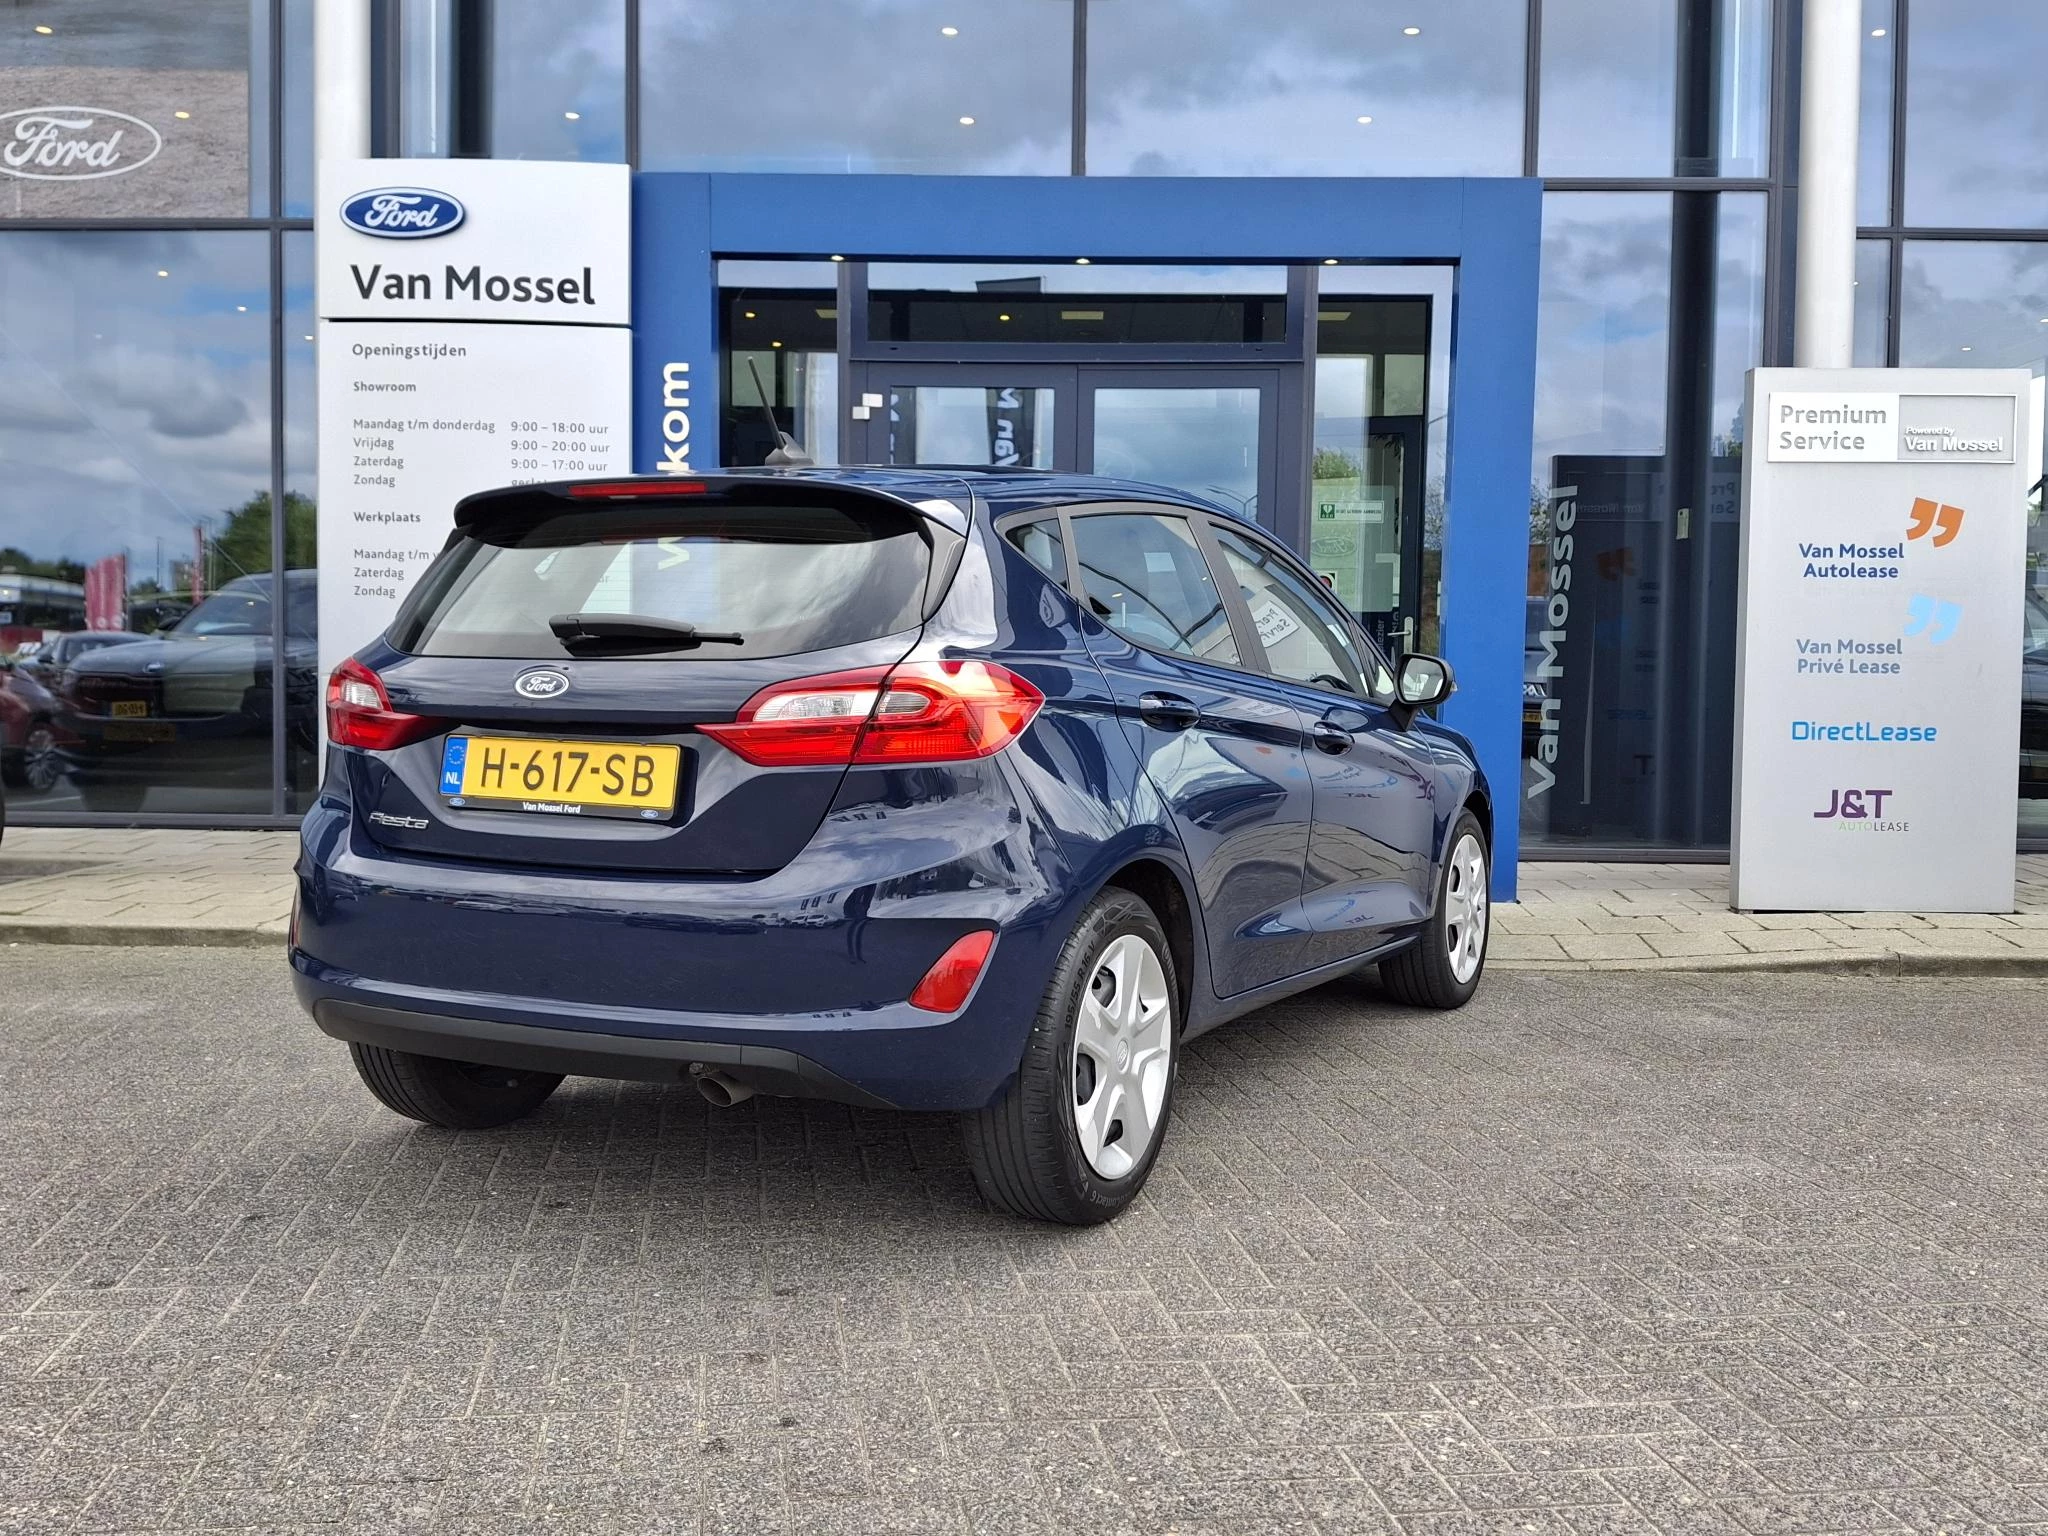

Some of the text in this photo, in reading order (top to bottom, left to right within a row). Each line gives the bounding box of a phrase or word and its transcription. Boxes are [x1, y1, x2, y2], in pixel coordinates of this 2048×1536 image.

[3, 116, 125, 168] Ford
[364, 194, 440, 228] Ford
[350, 264, 596, 305] Van Mossel
[352, 343, 467, 360] Openingstijden
[353, 381, 417, 392] Showroom
[1780, 405, 1887, 424] Premium
[353, 419, 405, 432] Maandag
[408, 419, 429, 430] t/m
[432, 419, 496, 433] donderdag
[511, 421, 538, 432] 9:00
[552, 422, 585, 434] 18:00
[589, 424, 609, 434] uur
[1905, 426, 1955, 437] Powered by
[353, 437, 394, 450] Vrijdag
[511, 440, 538, 451] 9:00
[552, 441, 587, 452] 20:00
[590, 443, 610, 453] uur
[1779, 431, 1865, 450] Service
[1904, 436, 2004, 453] Van Mossel
[354, 456, 404, 469] Zaterdag
[511, 458, 538, 470] 9:00
[553, 460, 584, 471] 17:00
[587, 462, 608, 472] uur
[354, 474, 396, 487] Zondag
[353, 511, 421, 523] Werkplaats
[354, 548, 405, 561] Maandag
[408, 549, 430, 560] t/m
[1799, 543, 1905, 559] Van Mossel
[354, 567, 404, 580] Zaterdag
[1803, 563, 1899, 579] Autolease
[1536, 484, 1578, 678] Mossel
[354, 585, 396, 598] Zondag
[1796, 638, 1903, 655] Van Mossel
[1797, 658, 1901, 674] Privé Lease
[526, 676, 557, 693] Ford
[1792, 721, 1938, 741] DirectLease
[1527, 698, 1562, 799] Van
[445, 770, 461, 785] NL
[481, 747, 655, 797] H-617-SB
[523, 802, 581, 813] Van Mossel Ford
[1813, 789, 1893, 819] J&T
[368, 810, 430, 830] Fiesta
[1838, 821, 1910, 832] AUTOLEASE
[1065, 981, 1081, 1029] 195/55
[1077, 968, 1085, 979] R
